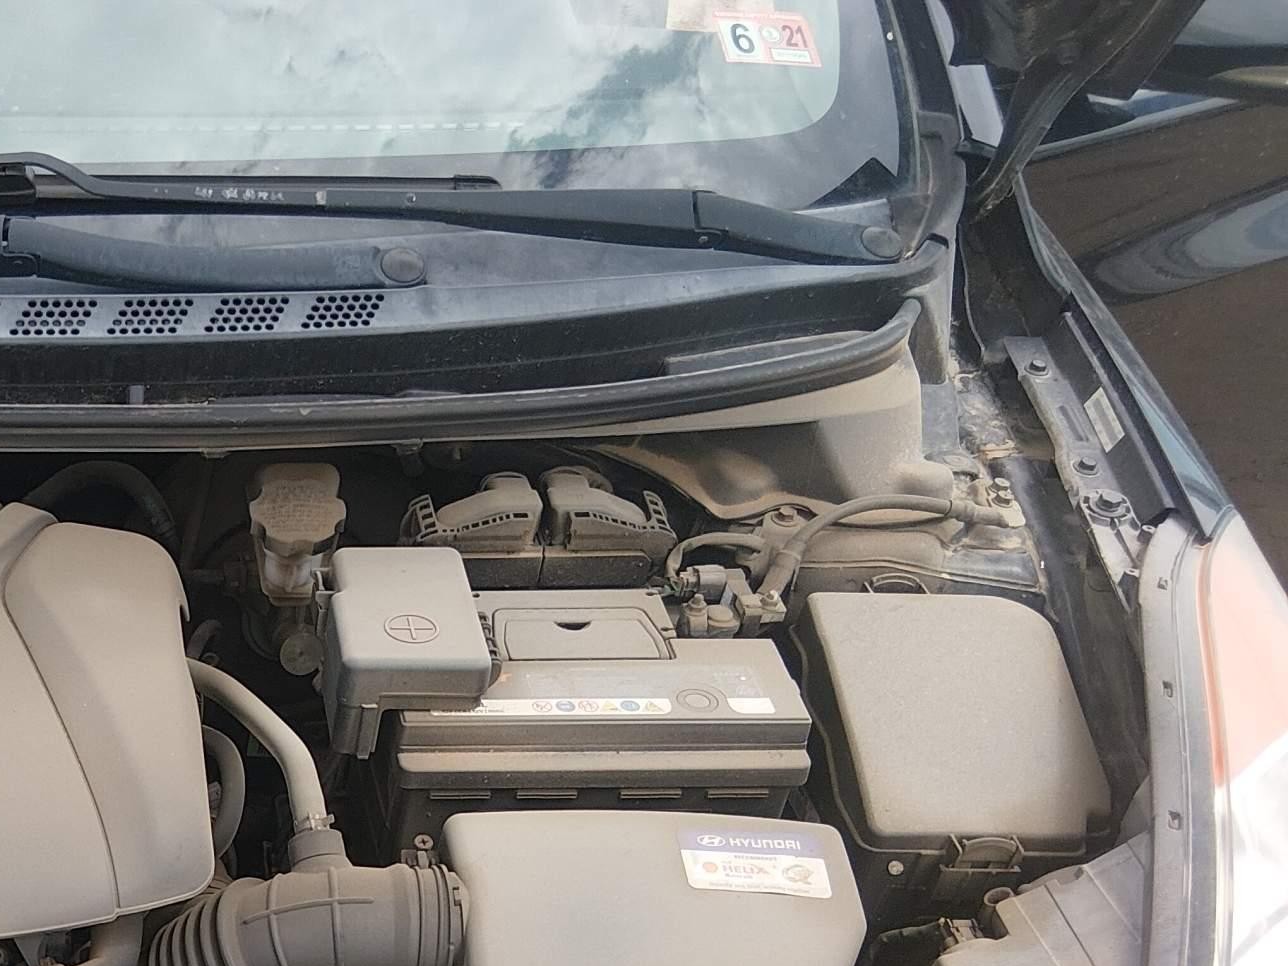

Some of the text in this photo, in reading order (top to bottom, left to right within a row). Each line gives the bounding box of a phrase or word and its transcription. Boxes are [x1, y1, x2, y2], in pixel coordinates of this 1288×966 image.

[731, 23, 808, 54] 6 21
[729, 838, 801, 850] HYUNDAI
